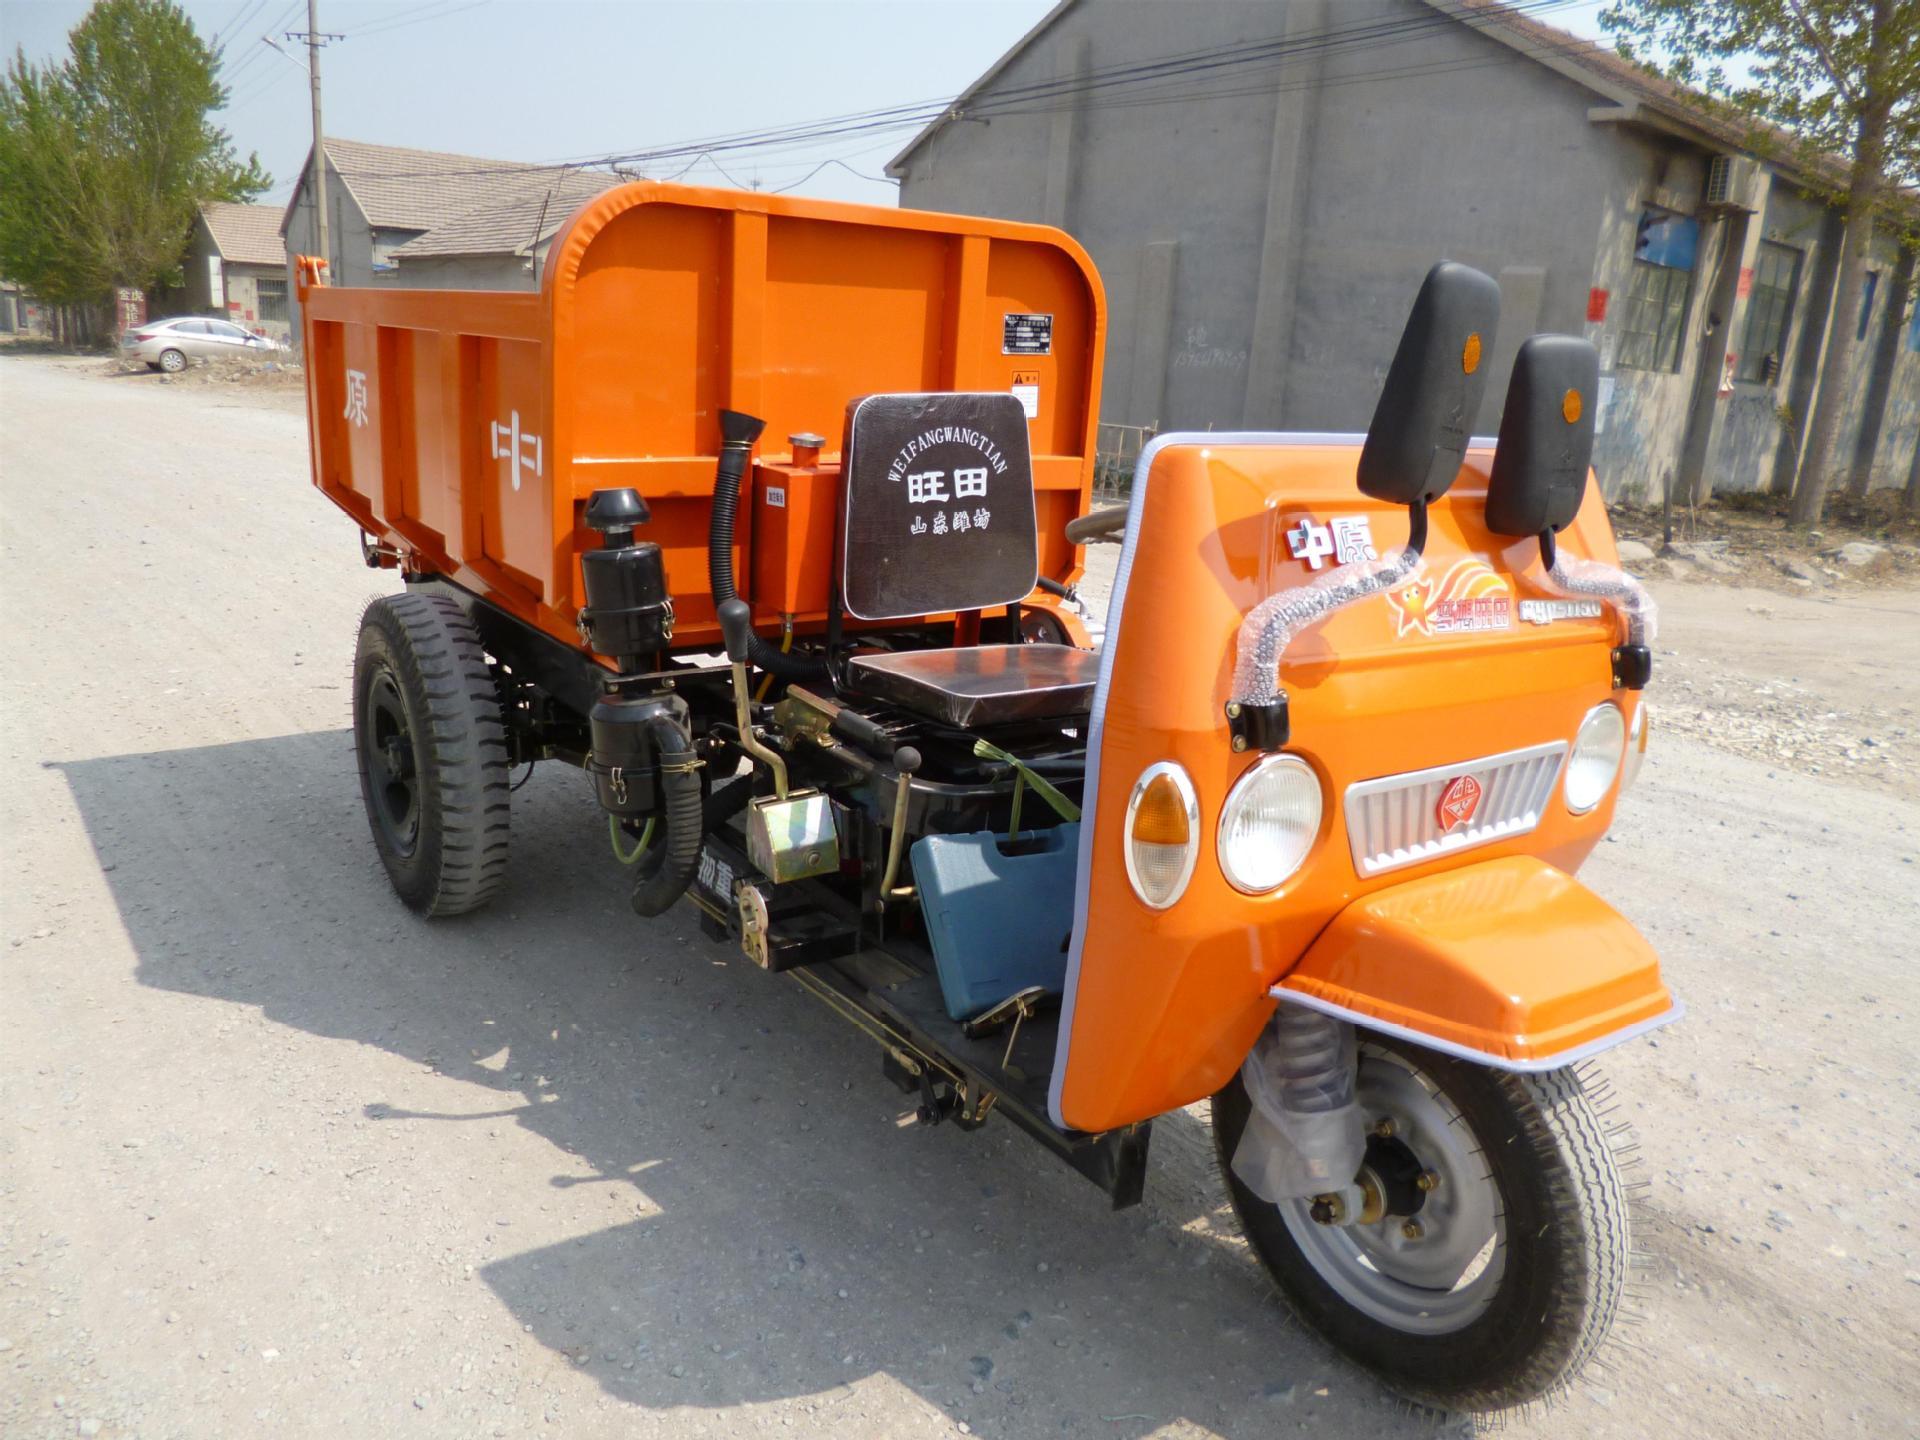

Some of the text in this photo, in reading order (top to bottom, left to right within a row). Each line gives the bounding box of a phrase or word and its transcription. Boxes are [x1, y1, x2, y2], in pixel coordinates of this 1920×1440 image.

[344, 368, 543, 491] 原 中
[888, 426, 1008, 482] WEIFANGWANGTIAN
[907, 467, 988, 504] 旺田
[910, 508, 991, 535] 山东潍坊
[1286, 515, 1378, 570] 中原
